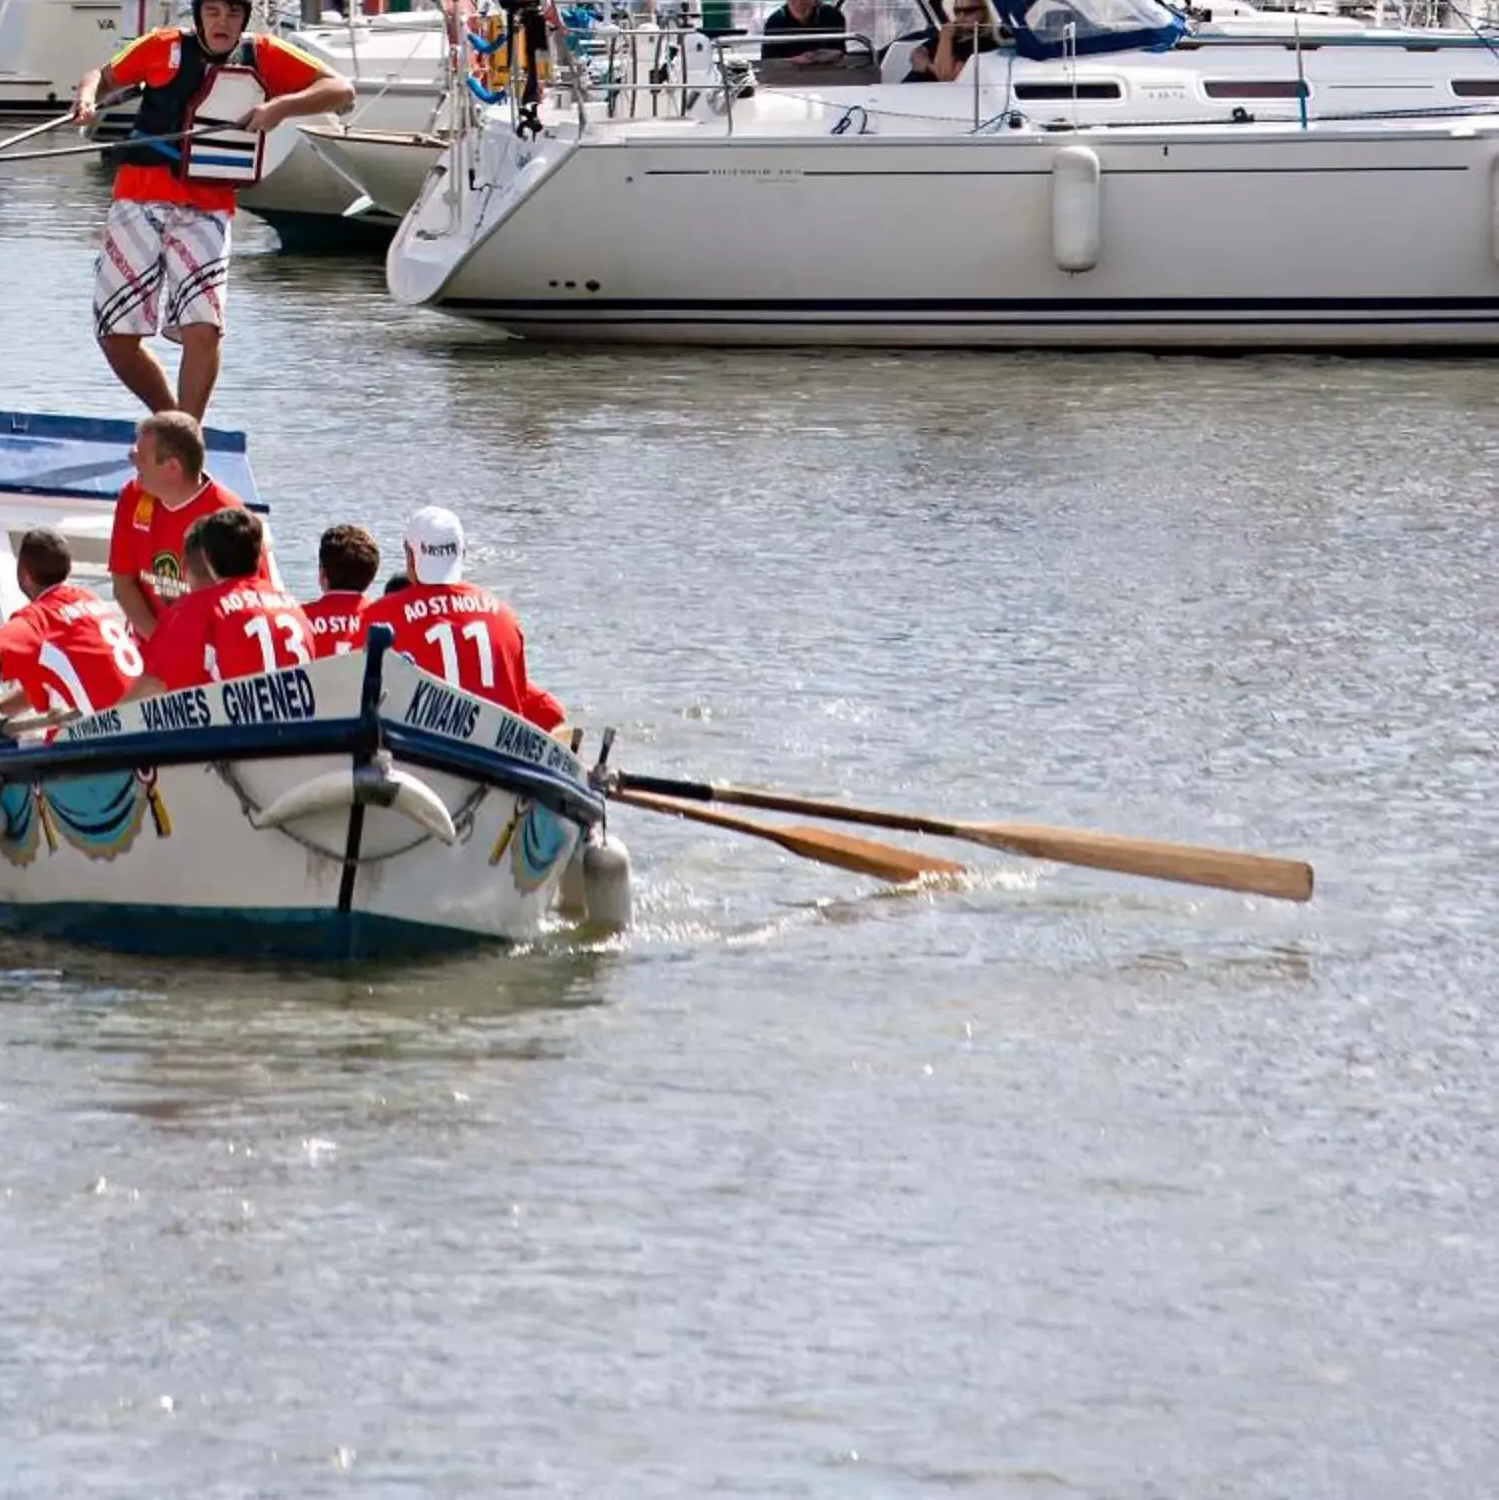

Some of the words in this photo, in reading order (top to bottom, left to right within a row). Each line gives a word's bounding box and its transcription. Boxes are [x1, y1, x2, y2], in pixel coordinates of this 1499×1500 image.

[97, 19, 117, 31] VA
[329, 615, 347, 633] ST
[404, 598, 429, 624] AO
[428, 594, 449, 616] ST
[99, 618, 144, 678] 8
[244, 613, 311, 673] 13
[424, 620, 495, 689] 11
[140, 686, 212, 730] VANNES
[222, 668, 317, 726] GWENED
[404, 680, 480, 741] KIWANIS
[495, 715, 547, 763] VANNES
